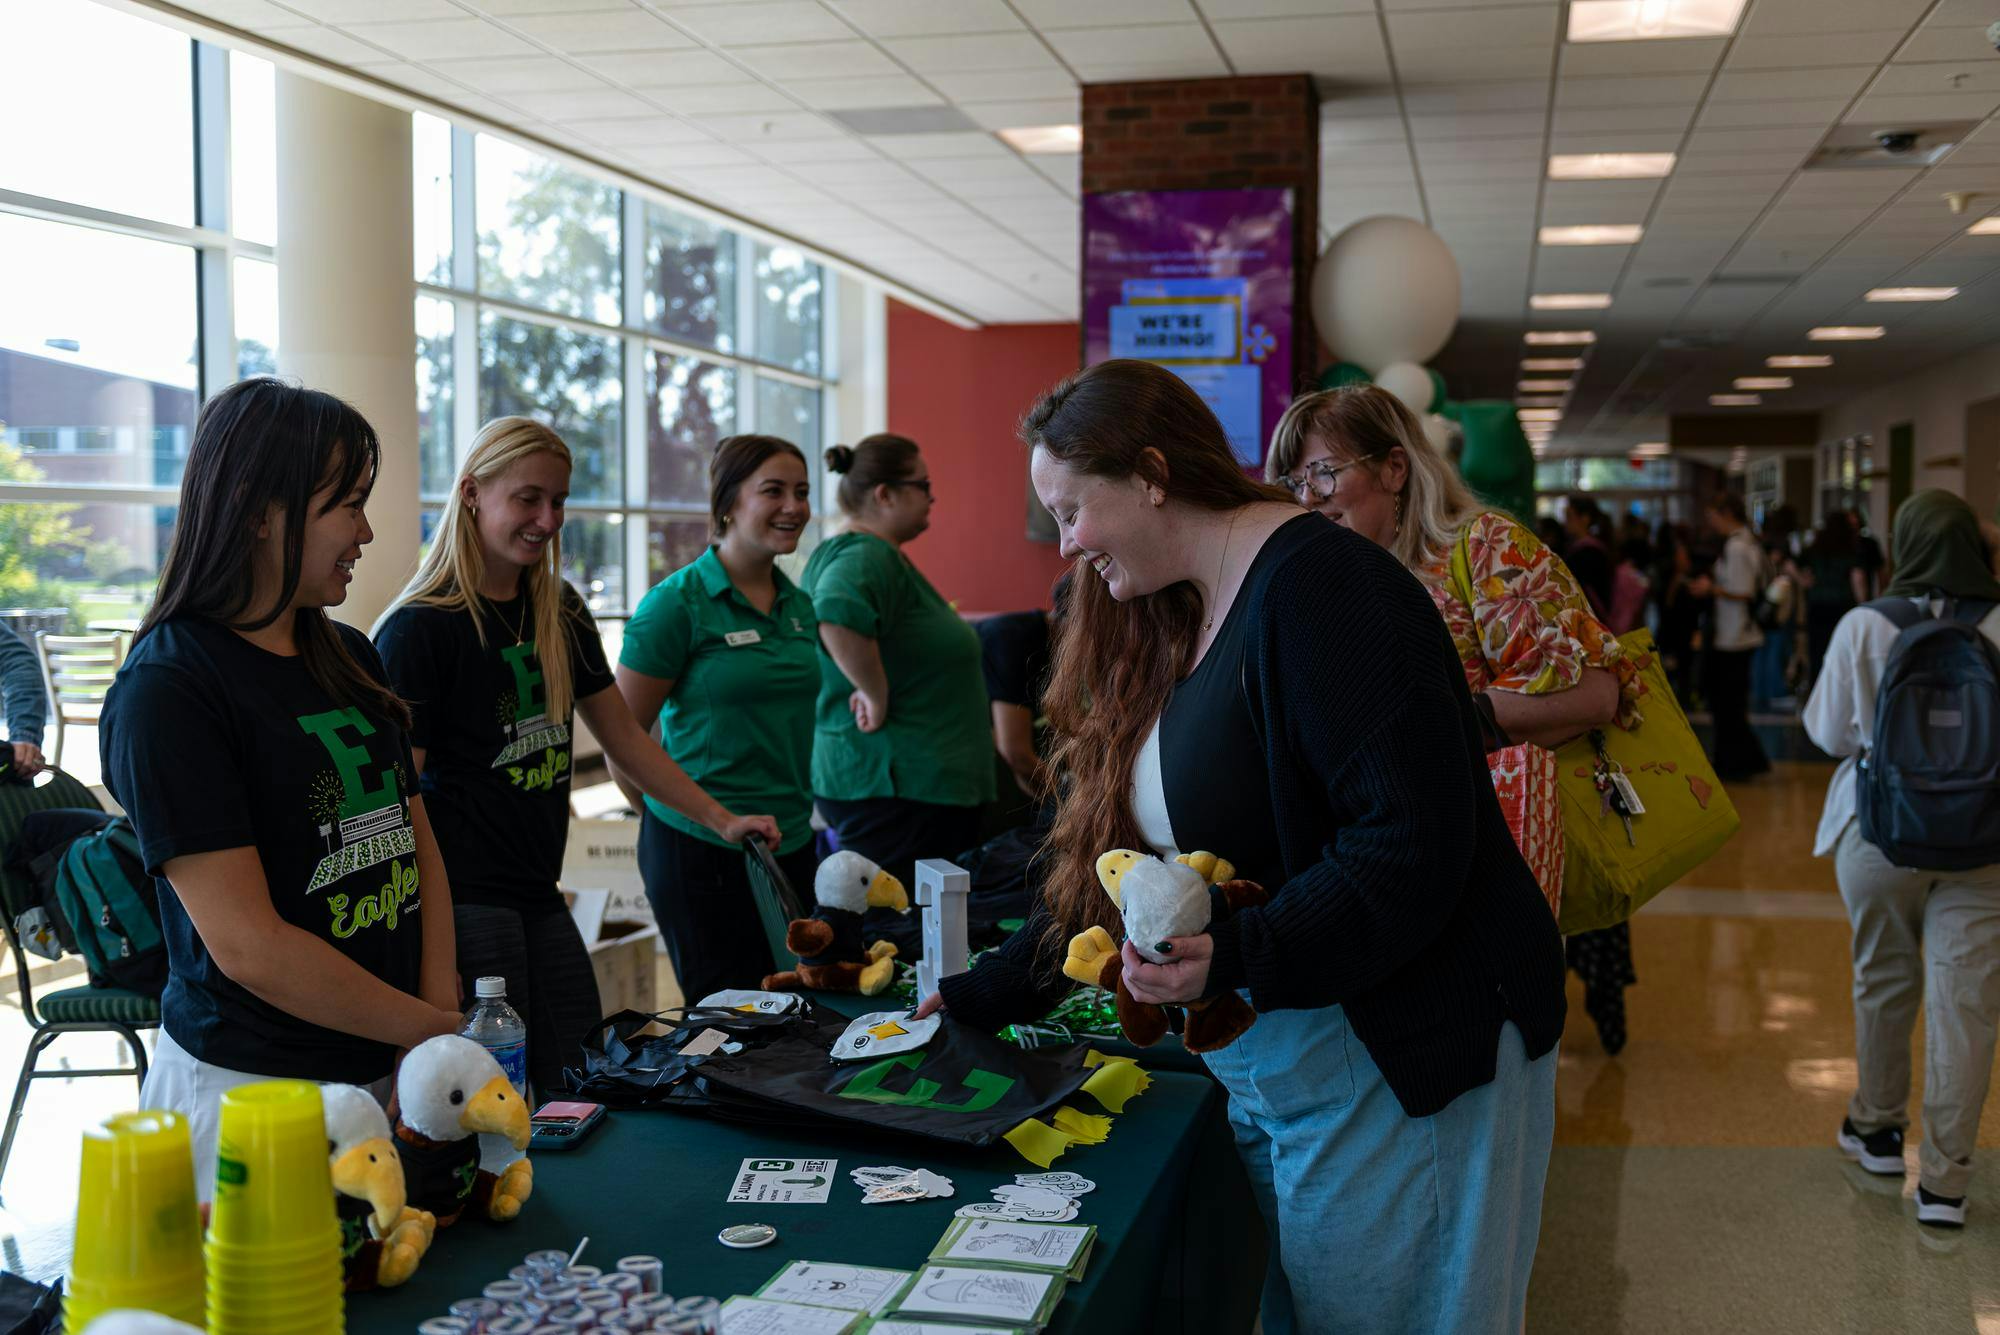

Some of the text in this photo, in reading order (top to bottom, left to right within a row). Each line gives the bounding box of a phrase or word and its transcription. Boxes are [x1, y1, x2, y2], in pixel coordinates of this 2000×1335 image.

[1140, 315, 1204, 330] WE'RE
[1135, 332, 1215, 348] HIRING!
[501, 641, 546, 721] E
[297, 706, 398, 819] E
[506, 746, 570, 792] Eagle
[586, 845, 637, 859] BE DIFFE
